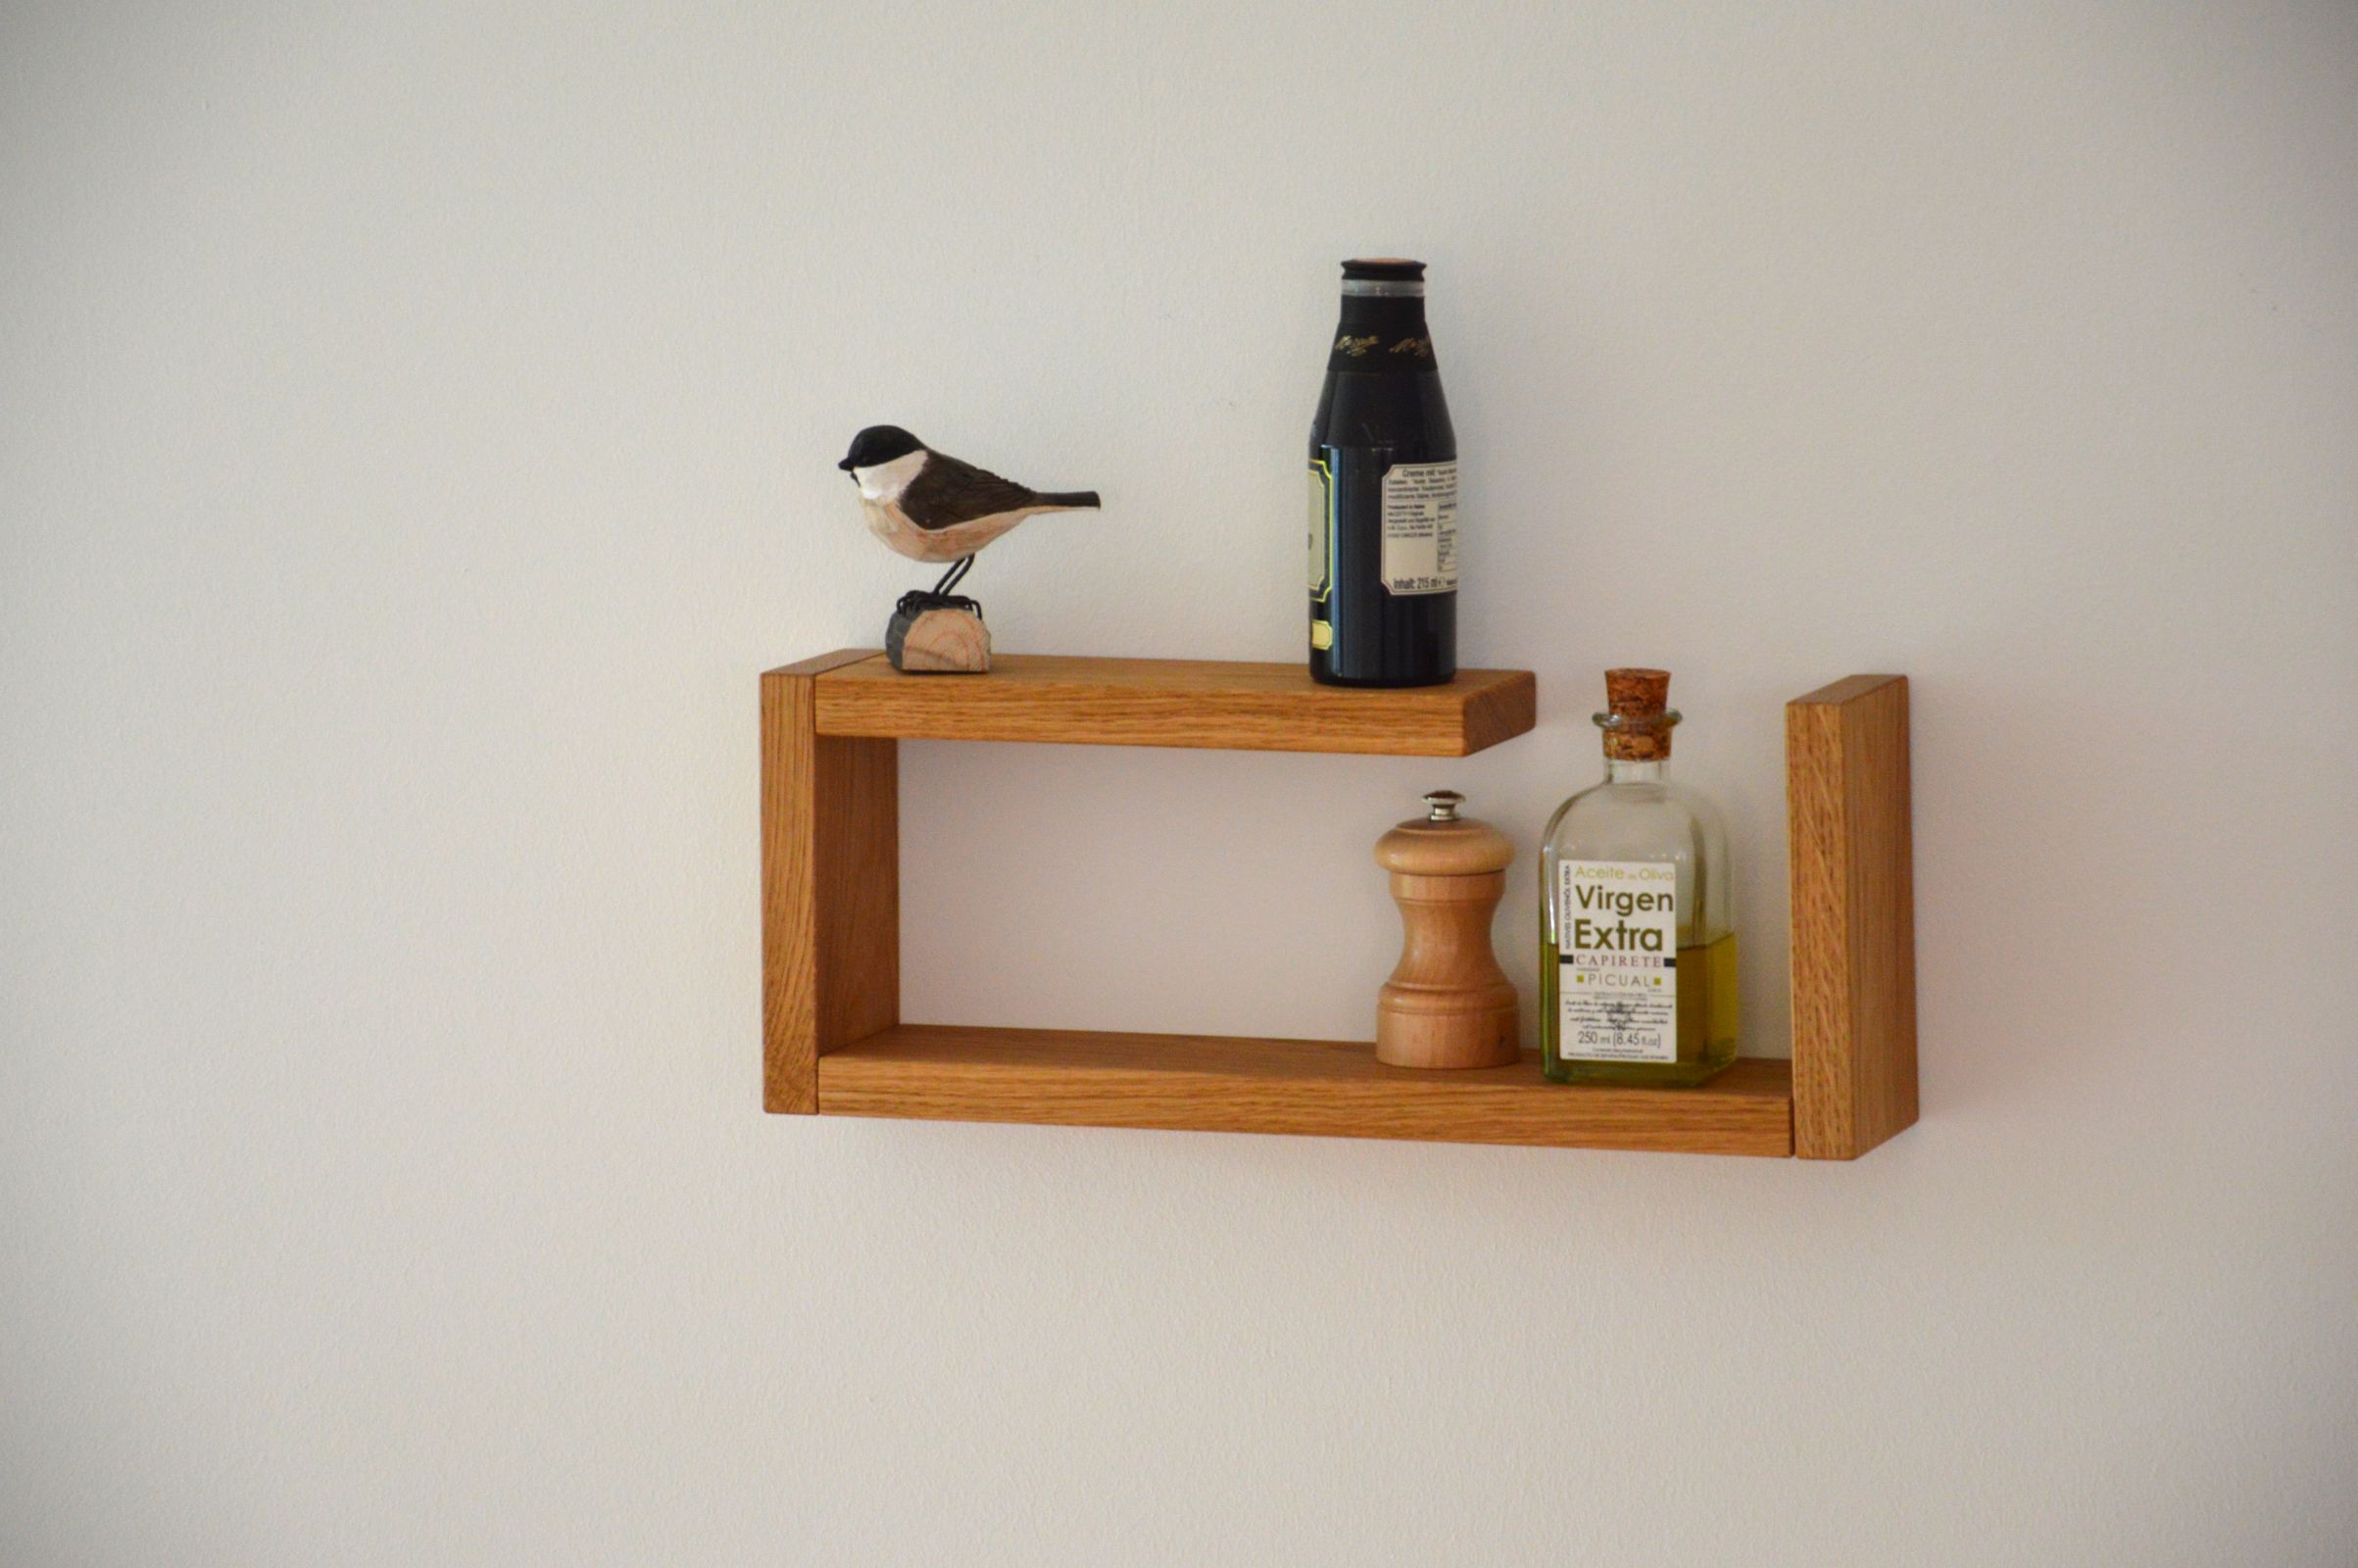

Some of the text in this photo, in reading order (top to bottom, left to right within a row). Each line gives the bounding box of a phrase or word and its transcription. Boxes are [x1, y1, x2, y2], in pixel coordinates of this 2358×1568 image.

[1575, 865, 1624, 880] Aceite
[1639, 867, 1674, 881] Oliva
[1575, 884, 1674, 917] Virgen
[1575, 918, 1663, 952] Extra
[1576, 955, 1662, 967] CAPIRETE
[1588, 973, 1650, 987] PICUAL
[1578, 1030, 1597, 1045] 250
[1599, 1034, 1610, 1045] ml
